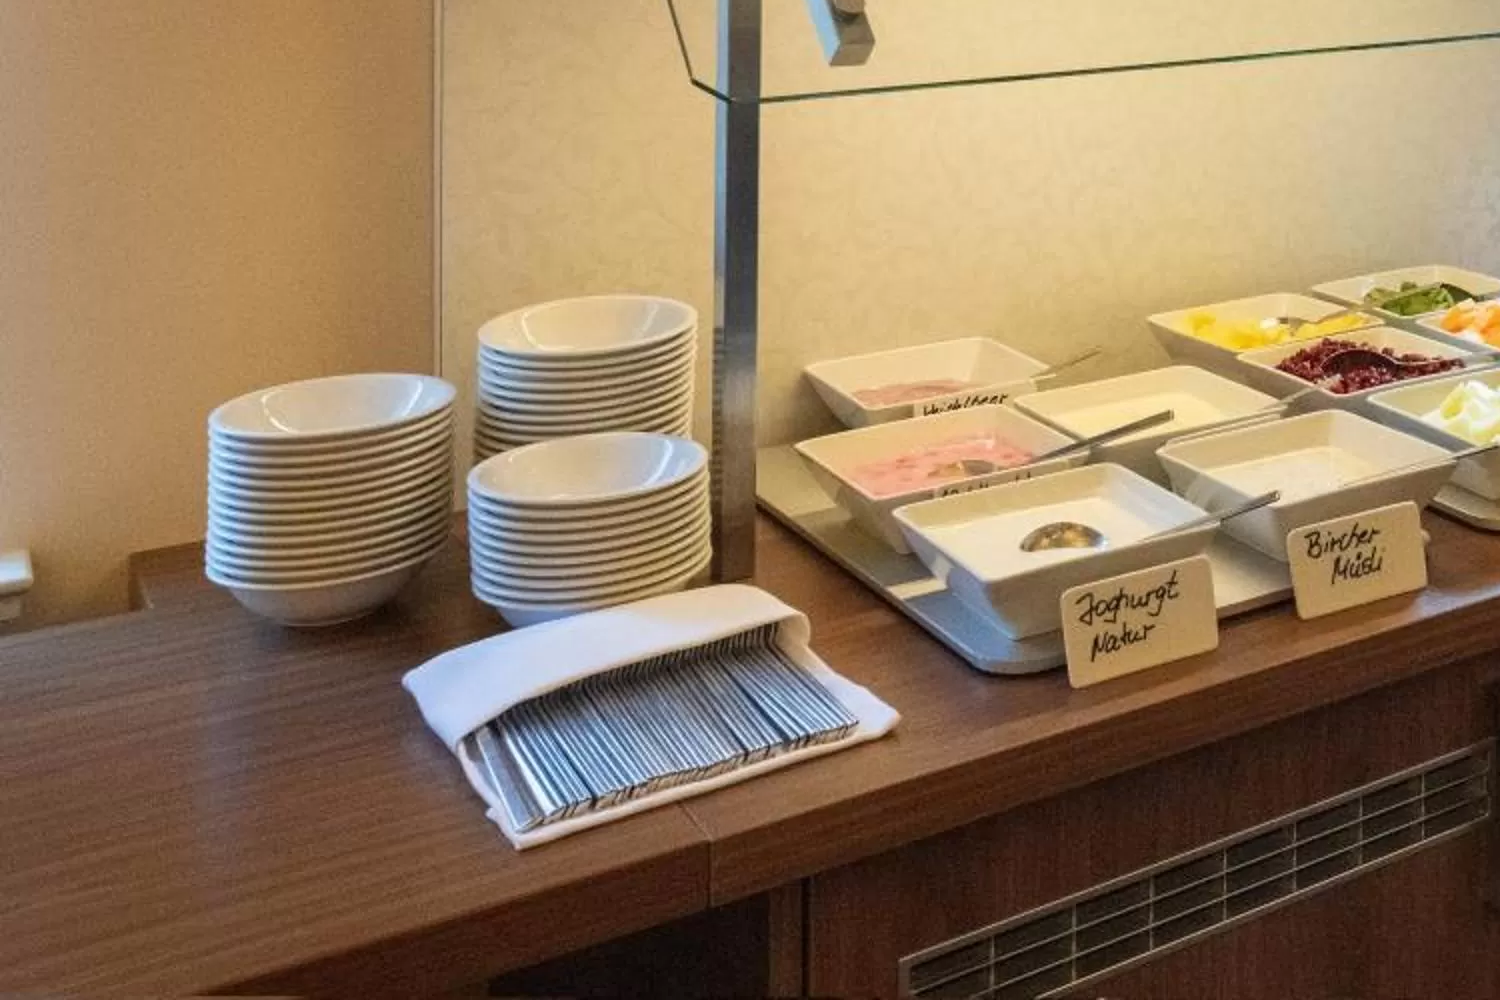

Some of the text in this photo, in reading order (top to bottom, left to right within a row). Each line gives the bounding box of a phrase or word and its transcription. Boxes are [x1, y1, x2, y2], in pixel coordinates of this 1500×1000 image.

[1304, 522, 1380, 559] Bircher
[1331, 546, 1386, 585] Müsli
[1090, 621, 1156, 662] Natur
